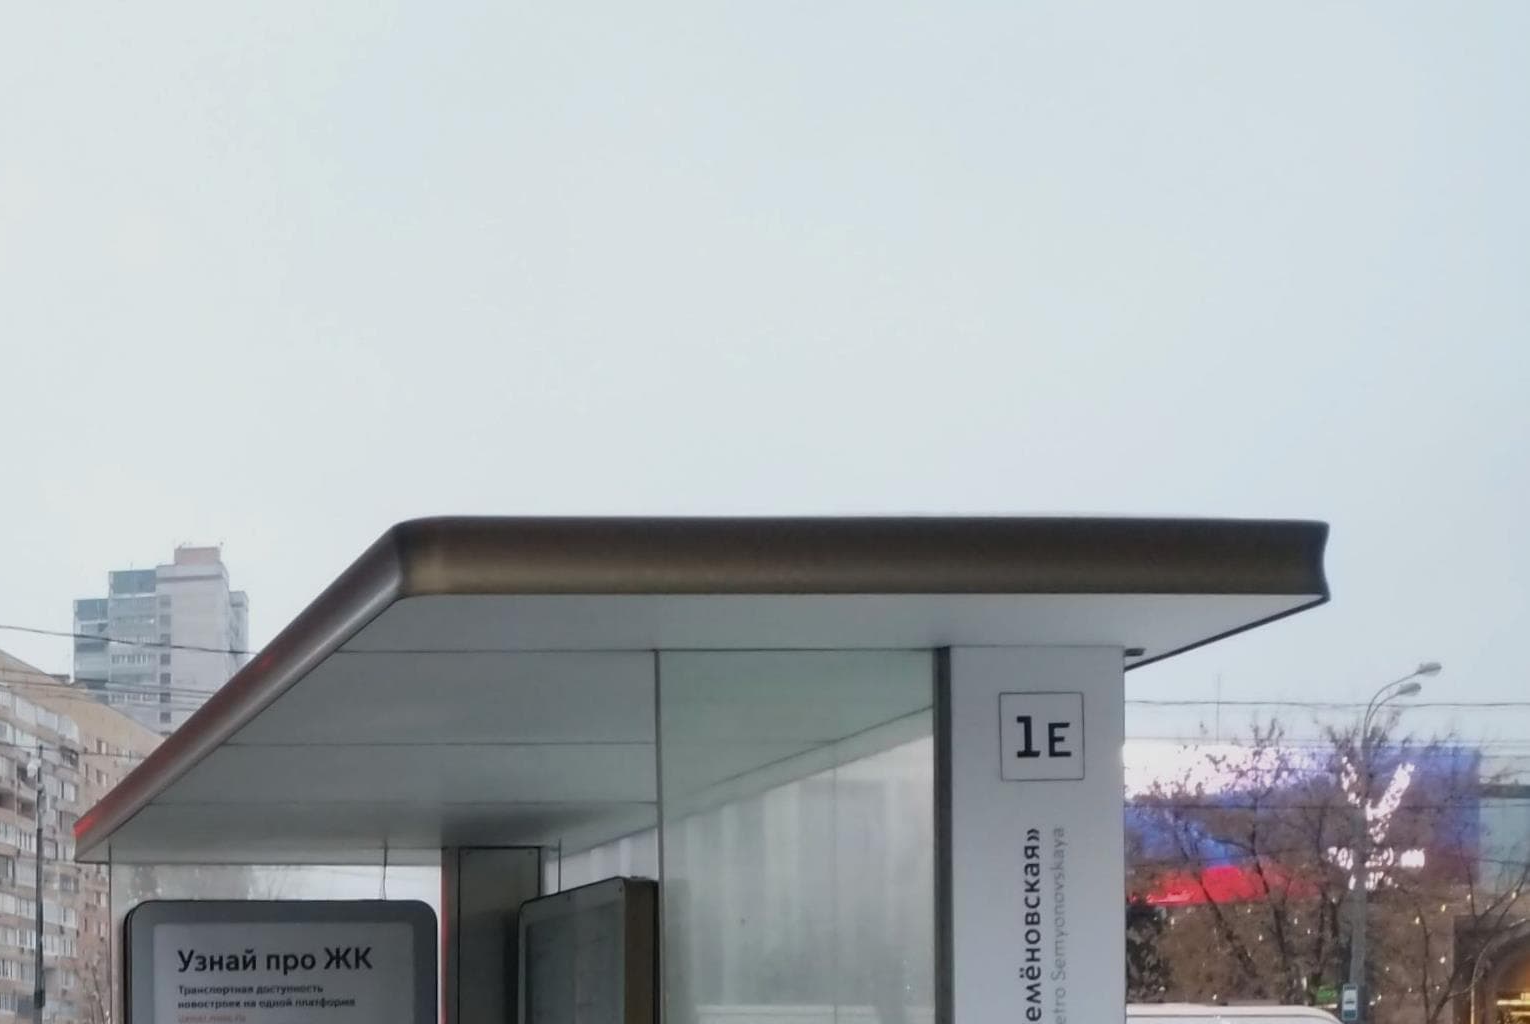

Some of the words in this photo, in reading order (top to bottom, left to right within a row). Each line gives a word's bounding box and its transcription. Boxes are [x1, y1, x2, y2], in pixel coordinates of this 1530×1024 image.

[1016, 715, 1072, 758] 1Е
[1050, 827, 1070, 981] Semyonovskaya
[177, 949, 257, 973] Узнай
[266, 953, 316, 975] про
[324, 947, 373, 970] ЖК
[177, 1000, 241, 1011] новостроек
[243, 1000, 257, 1009] на
[258, 998, 293, 1009] одной
[295, 997, 356, 1009] платформе
[178, 985, 254, 996] Транспортная
[256, 984, 324, 996] доступность
